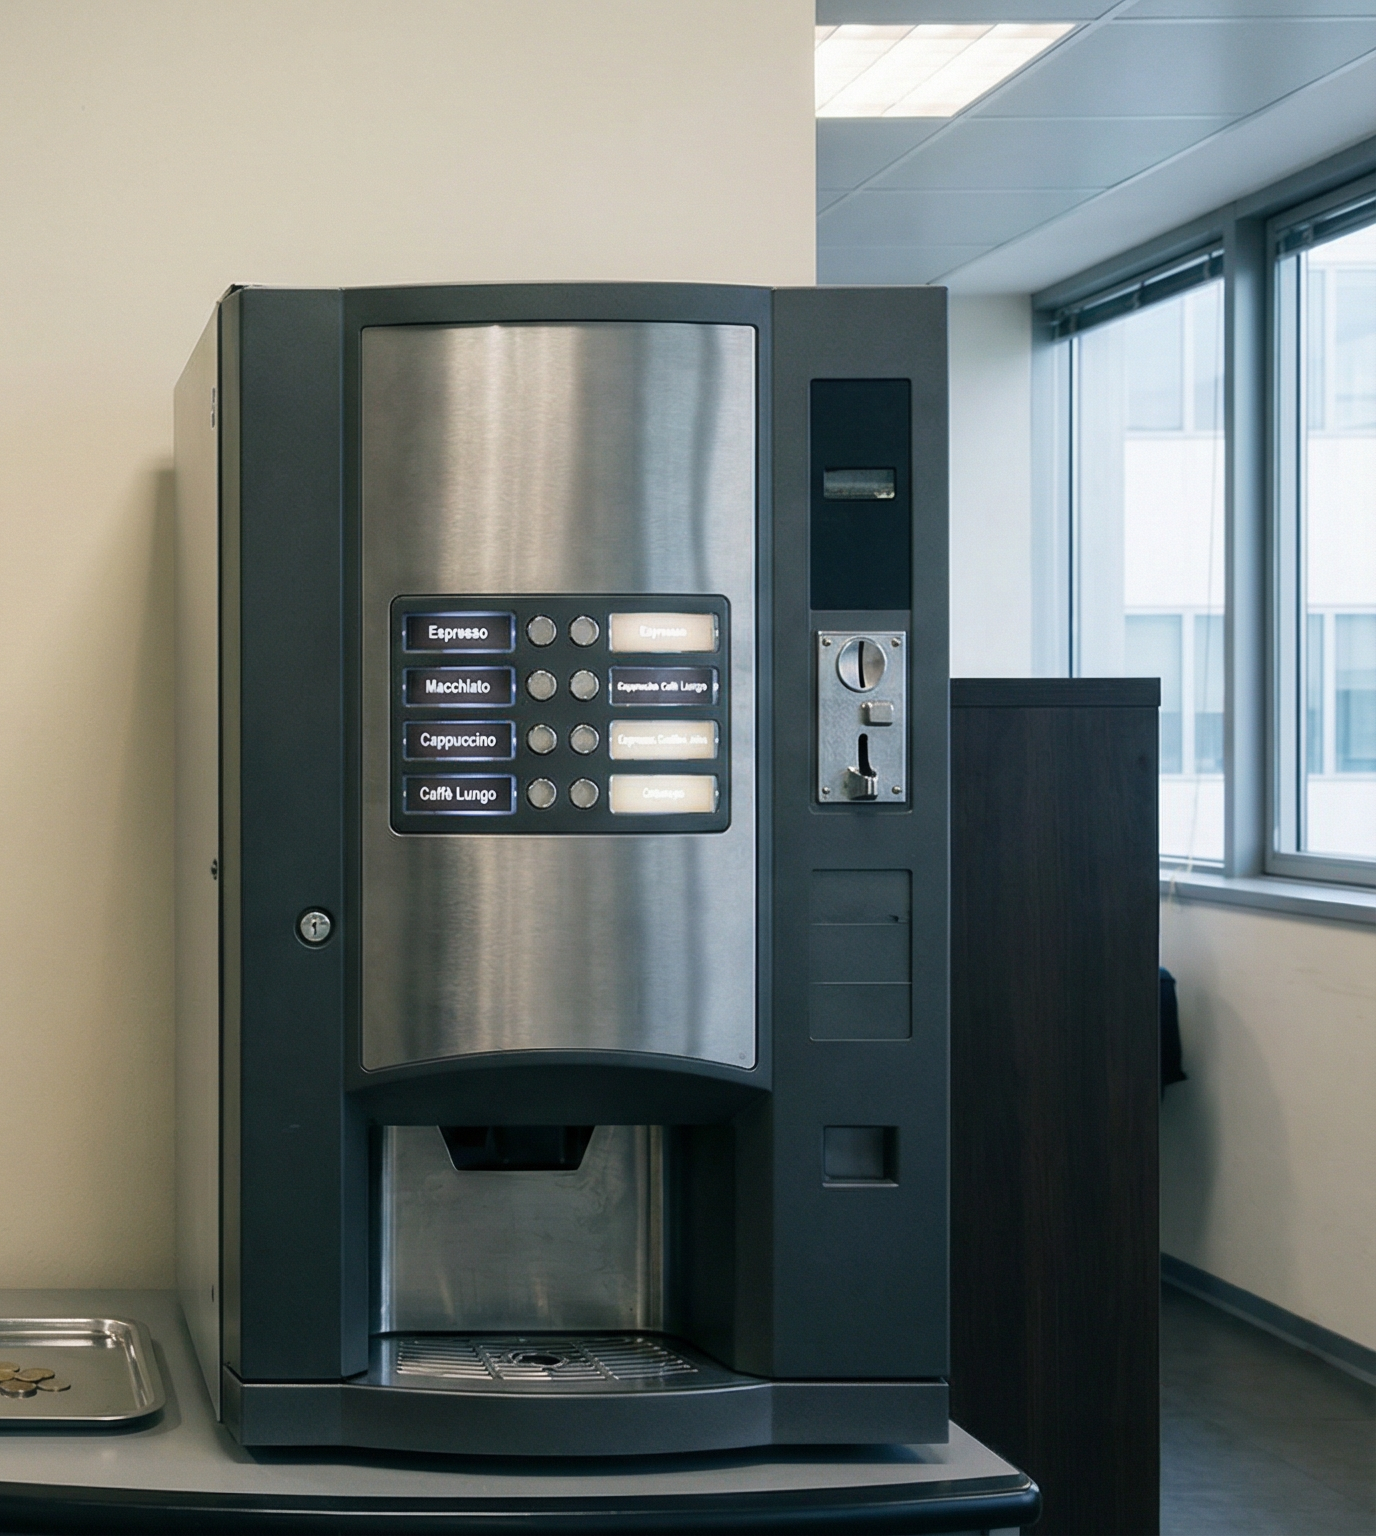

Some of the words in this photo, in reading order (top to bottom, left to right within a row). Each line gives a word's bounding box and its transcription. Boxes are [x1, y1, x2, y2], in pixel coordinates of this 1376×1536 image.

[425, 678, 491, 694] Macchiato
[420, 732, 497, 751] Cappuccino
[419, 786, 454, 801] Caffè
[456, 786, 497, 805] Lungo
